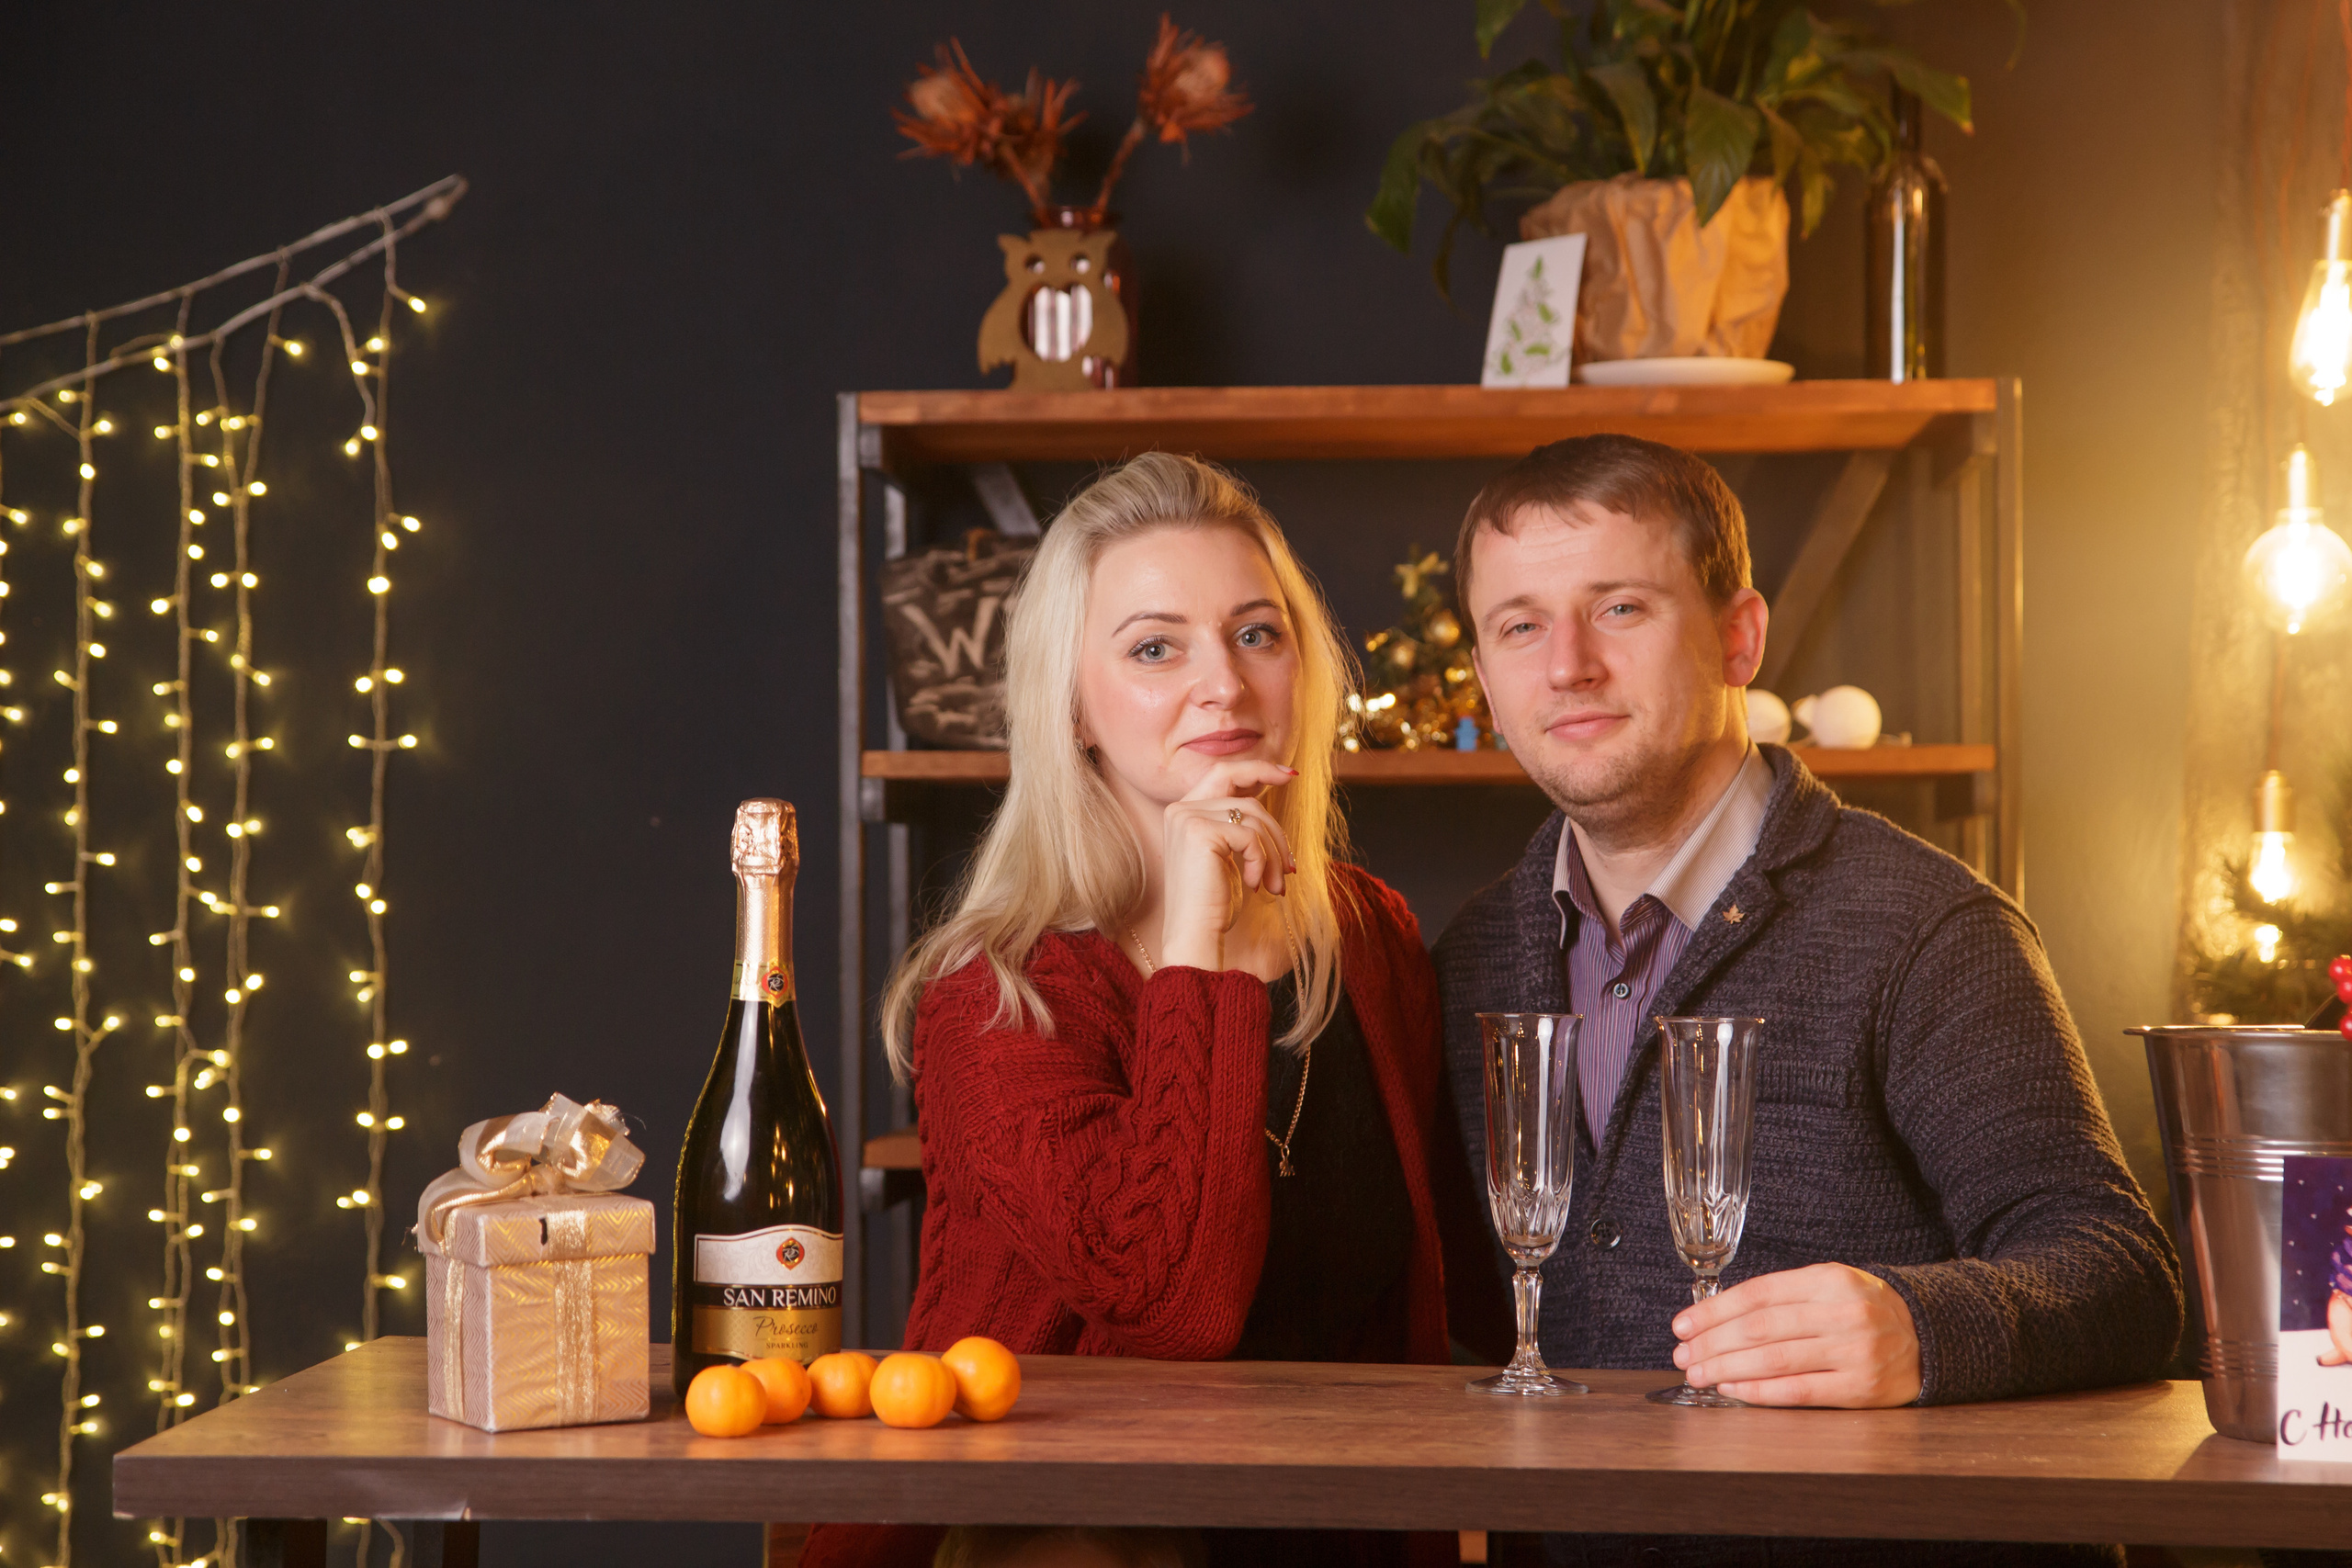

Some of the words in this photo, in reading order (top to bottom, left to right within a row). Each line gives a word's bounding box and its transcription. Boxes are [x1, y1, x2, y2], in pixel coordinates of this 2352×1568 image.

[723, 1288, 764, 1307] SAN
[772, 1286, 837, 1307] REMINO
[752, 1315, 819, 1337] Prosecco
